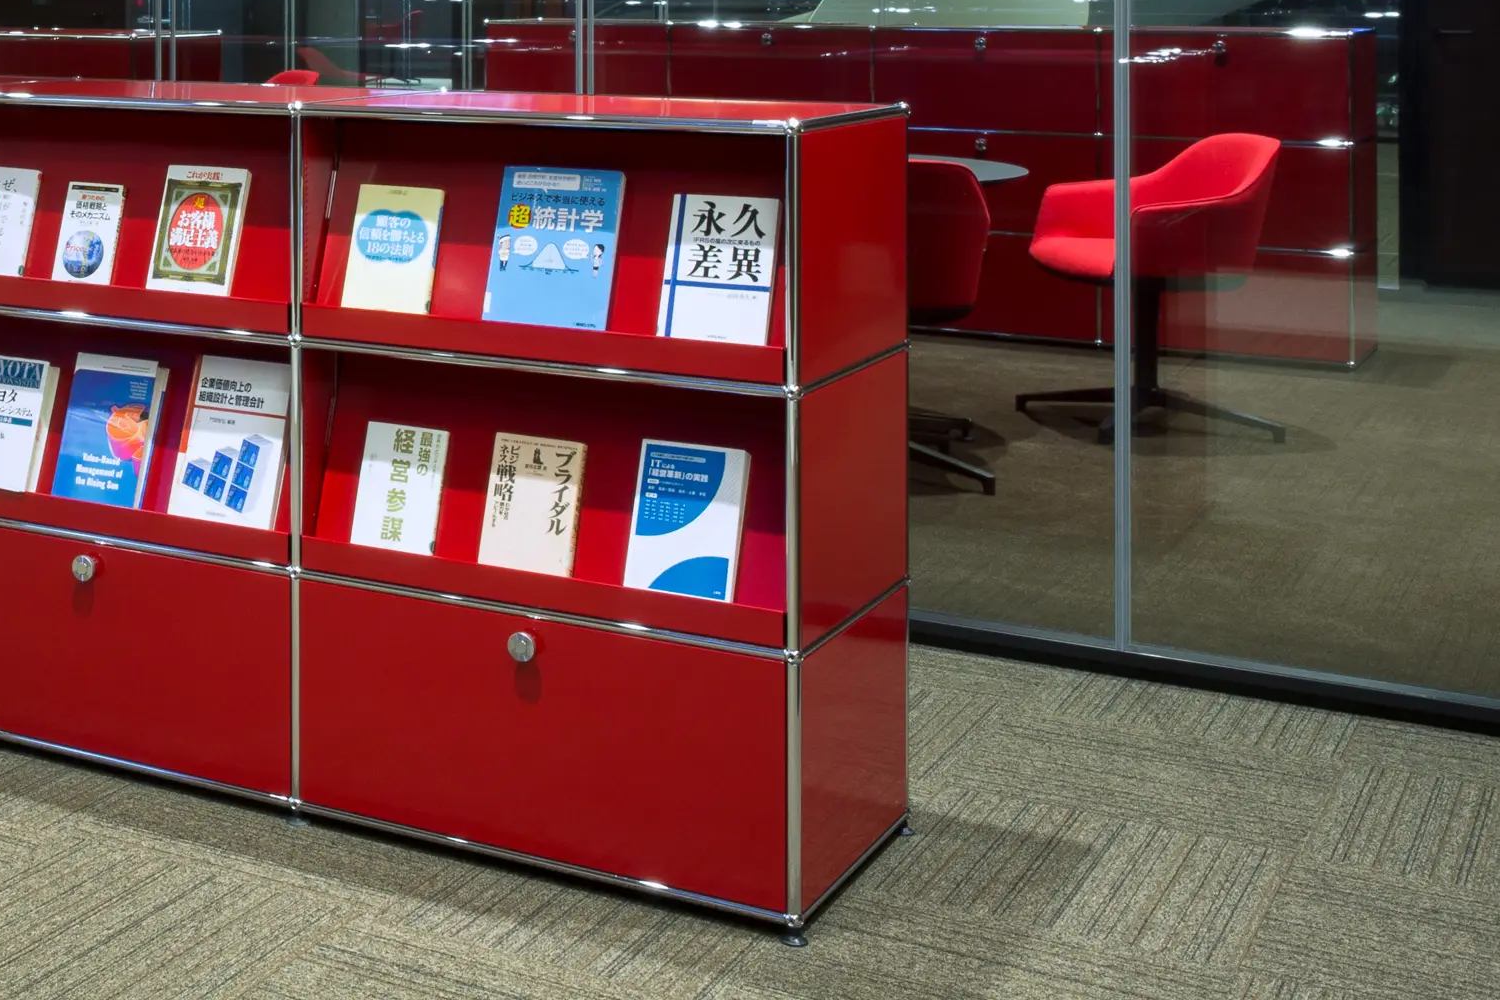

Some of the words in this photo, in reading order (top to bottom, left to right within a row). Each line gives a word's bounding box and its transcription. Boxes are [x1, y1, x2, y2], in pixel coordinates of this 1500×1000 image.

[511, 192, 606, 207] ビジネスで本当に使える
[70, 210, 110, 221] そのメカニズム
[690, 200, 767, 239] 永久
[367, 241, 414, 257] 18の法則
[687, 243, 762, 283] 差異
[201, 376, 252, 393] 企業価値向上の
[198, 390, 265, 409] 組織設計と管理会計
[83, 452, 120, 466] Value-Based
[417, 431, 434, 476] 最強の
[76, 463, 116, 477] Management
[106, 480, 119, 490] Sun
[380, 428, 416, 542] 経営参謀
[546, 450, 577, 536] ブライダル
